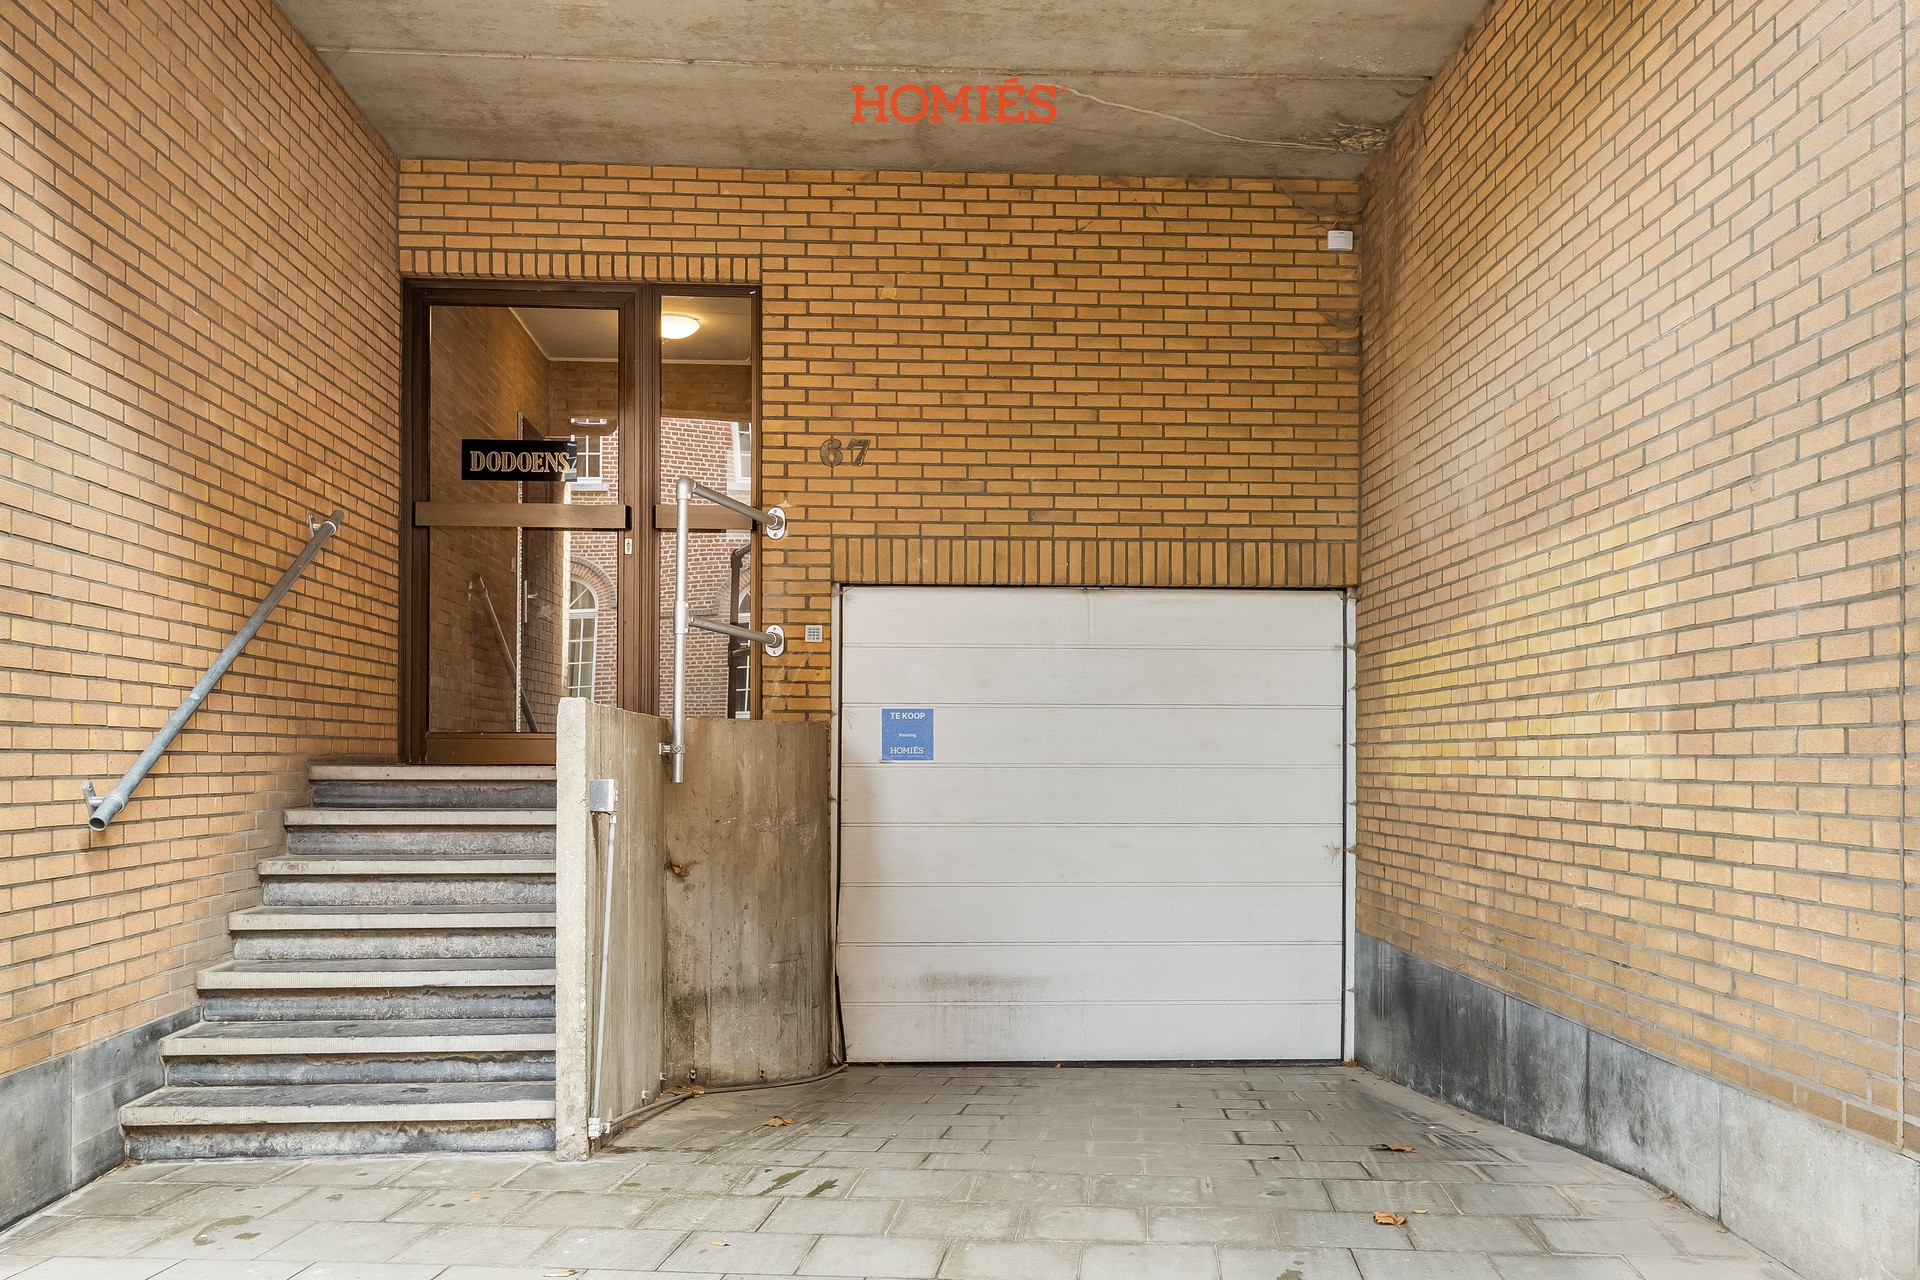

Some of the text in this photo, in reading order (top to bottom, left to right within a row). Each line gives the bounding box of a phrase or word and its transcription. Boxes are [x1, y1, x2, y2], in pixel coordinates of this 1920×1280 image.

[470, 450, 570, 473] DODOENS
[820, 438, 871, 467] 67
[890, 746, 924, 754] HOMIÉS
